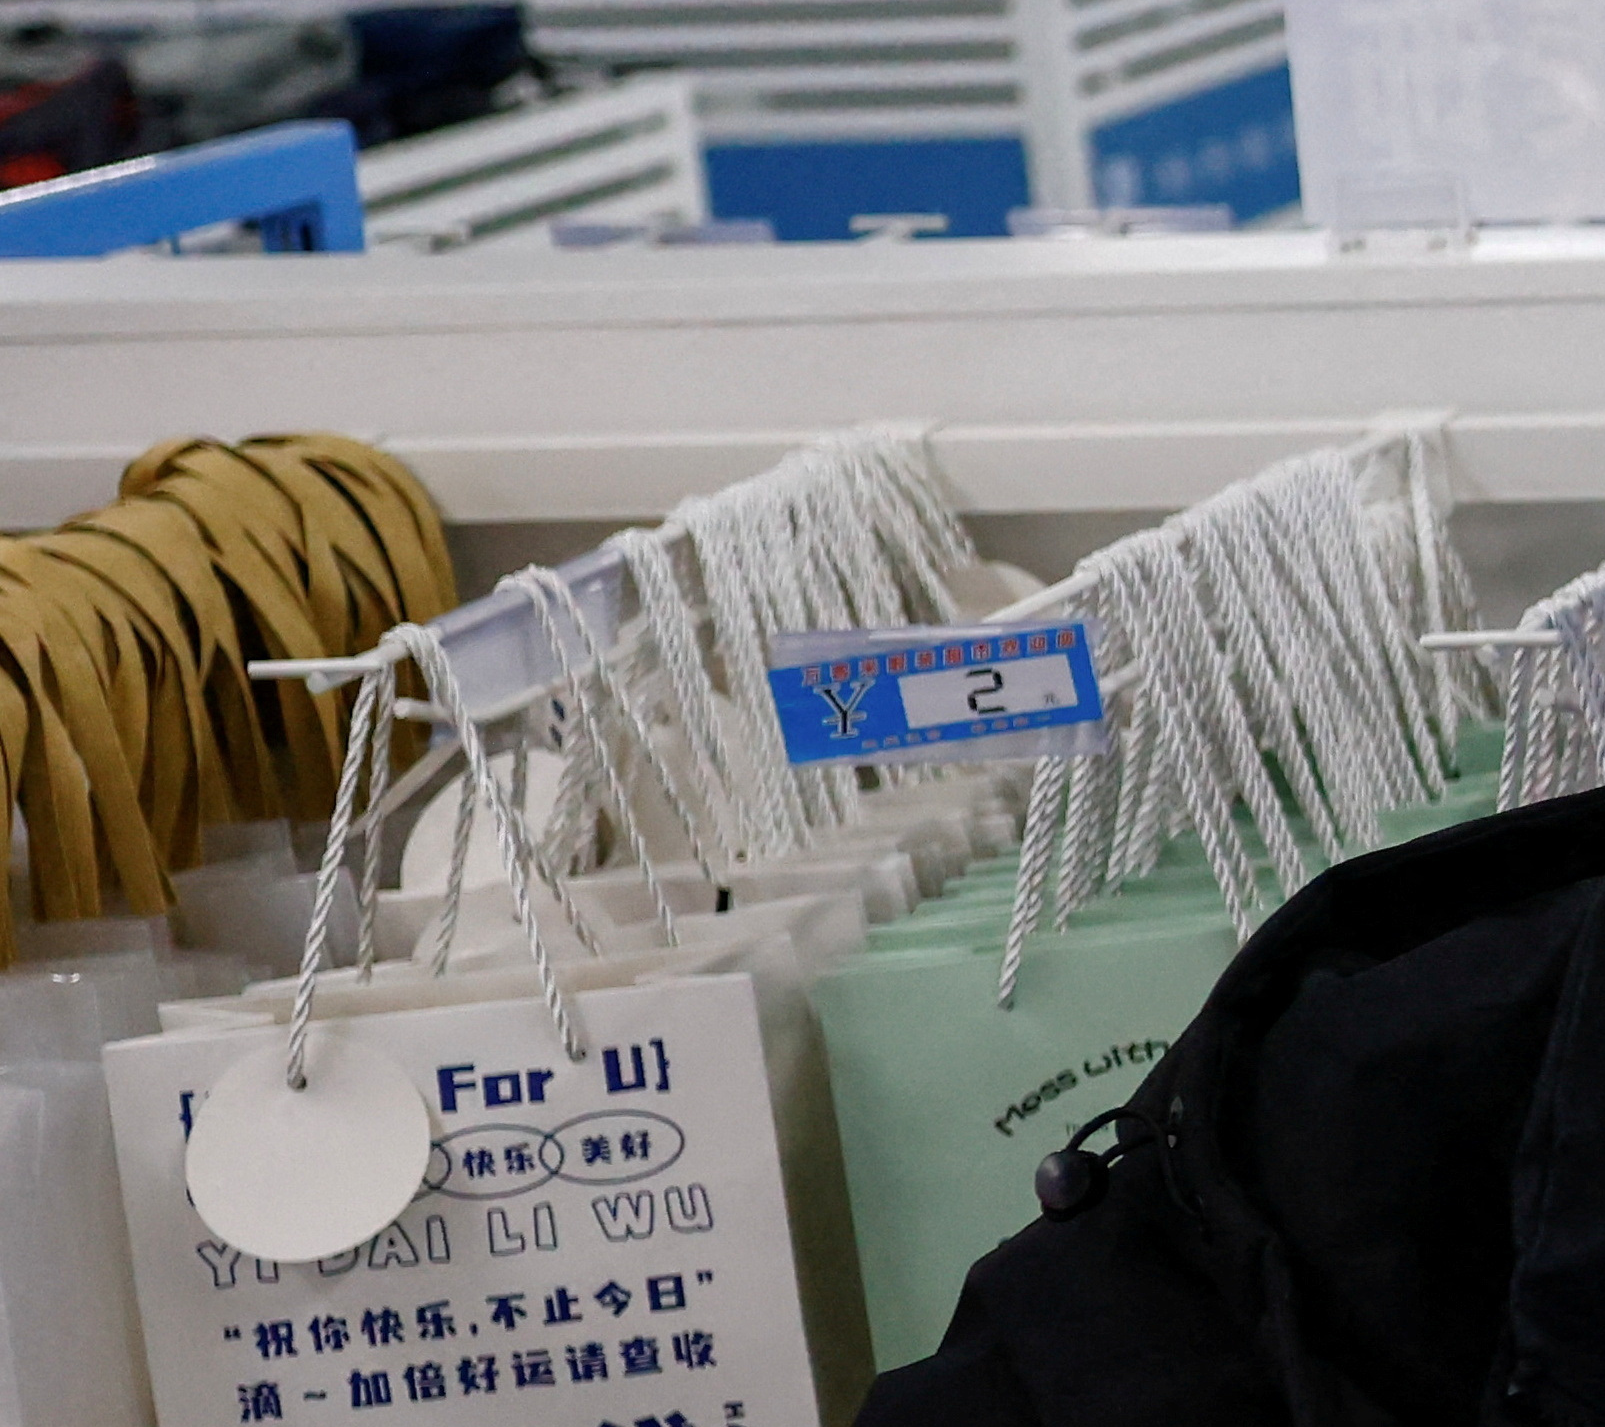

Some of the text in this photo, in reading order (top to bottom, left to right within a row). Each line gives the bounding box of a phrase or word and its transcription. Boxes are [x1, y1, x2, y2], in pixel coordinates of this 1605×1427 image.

[966, 668, 1008, 714] 2
[435, 1060, 556, 1115] For
[995, 1069, 1078, 1138] Moss
[461, 1142, 538, 1179] 快乐
[580, 1130, 654, 1167] 美好
[486, 1201, 559, 1257] LI
[591, 1182, 716, 1245] WU
